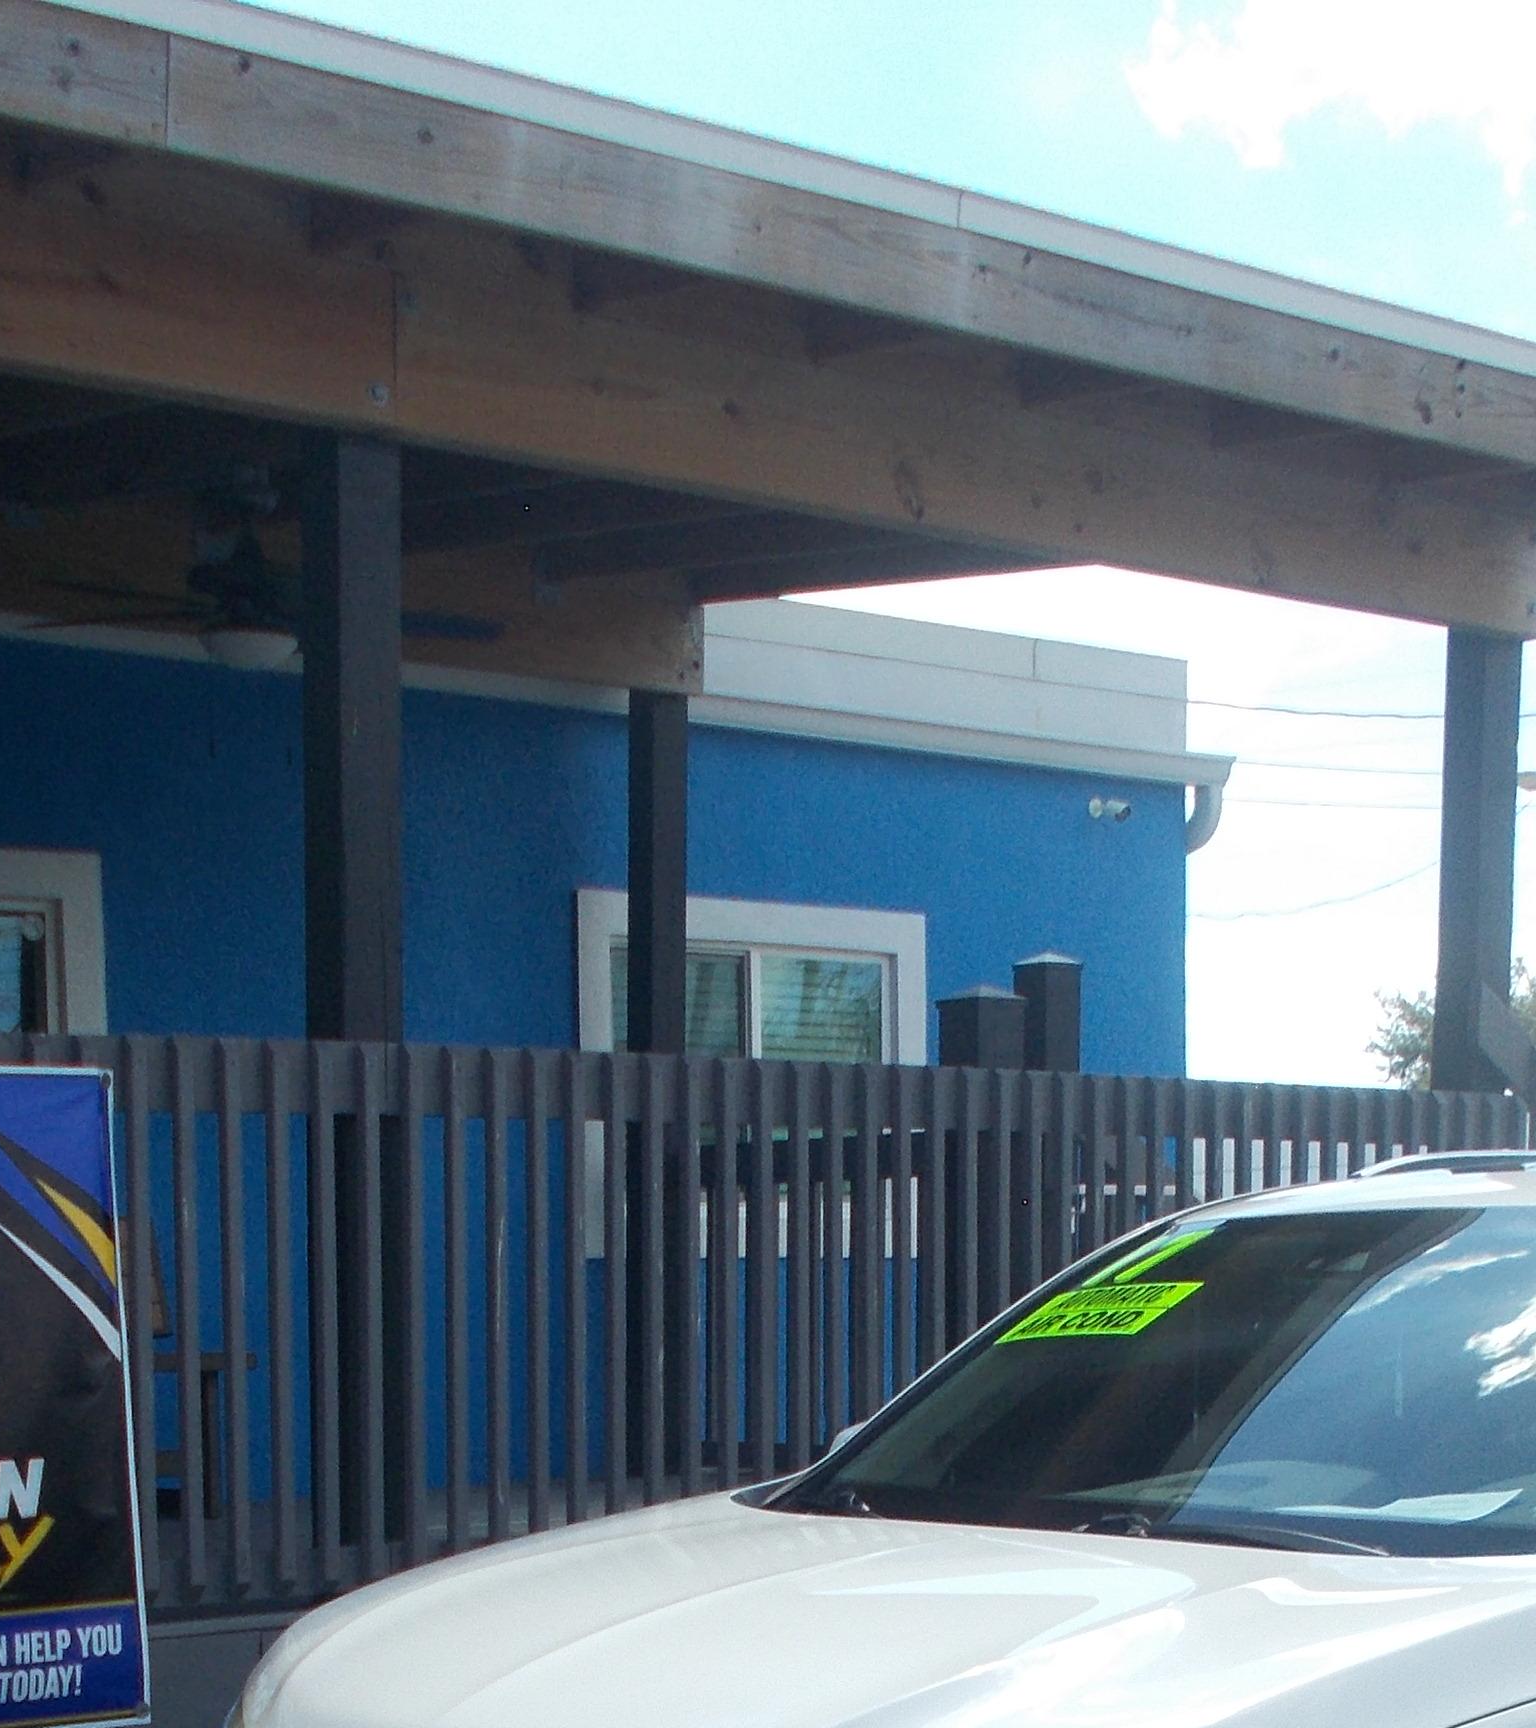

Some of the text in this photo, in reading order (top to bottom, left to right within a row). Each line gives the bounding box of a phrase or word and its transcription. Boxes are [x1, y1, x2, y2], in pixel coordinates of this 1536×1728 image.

[1019, 1310, 1145, 1334] AIR COND
[14, 1629, 72, 1666] HELP
[78, 1623, 123, 1659] YOU
